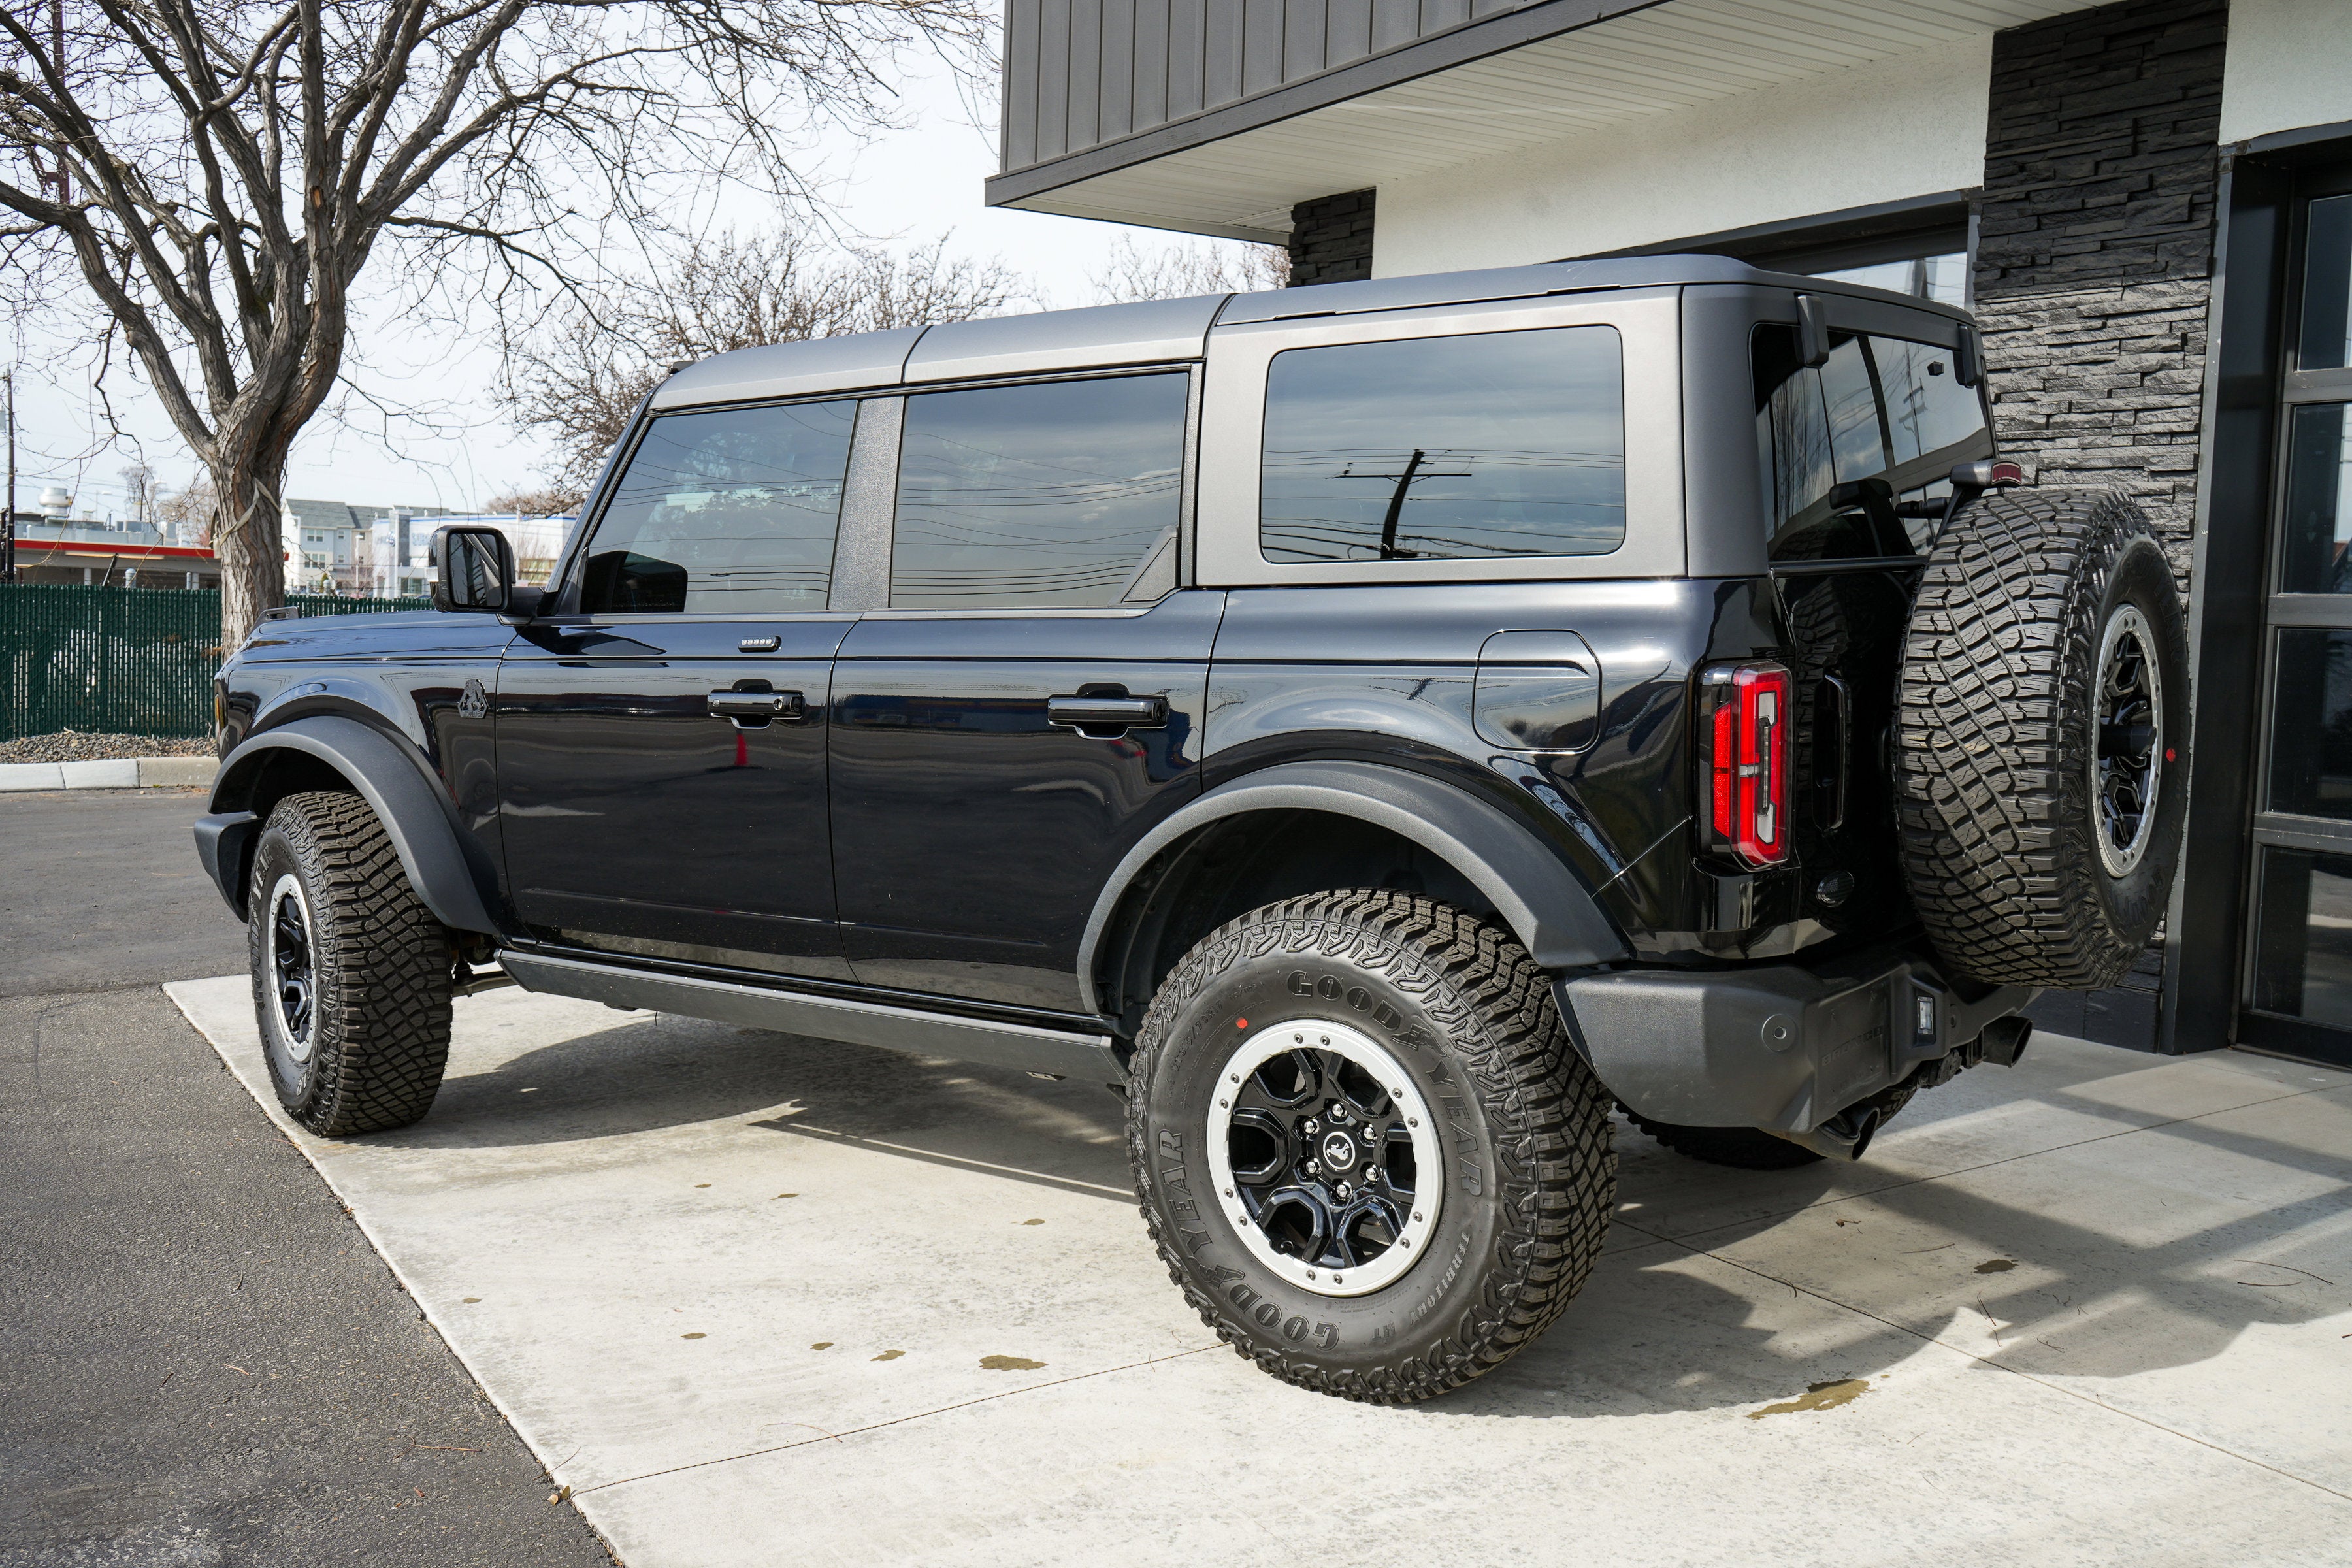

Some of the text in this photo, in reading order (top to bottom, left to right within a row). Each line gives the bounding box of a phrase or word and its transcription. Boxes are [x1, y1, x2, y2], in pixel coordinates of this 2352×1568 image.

[250, 843, 274, 1010] GOODYEAR
[1286, 970, 1483, 1197] GOODYEAR
[1158, 1128, 1340, 1350] GOODYEAR
[1409, 1230, 1471, 1326] TERRITORY
[1372, 1321, 1396, 1340] MT
